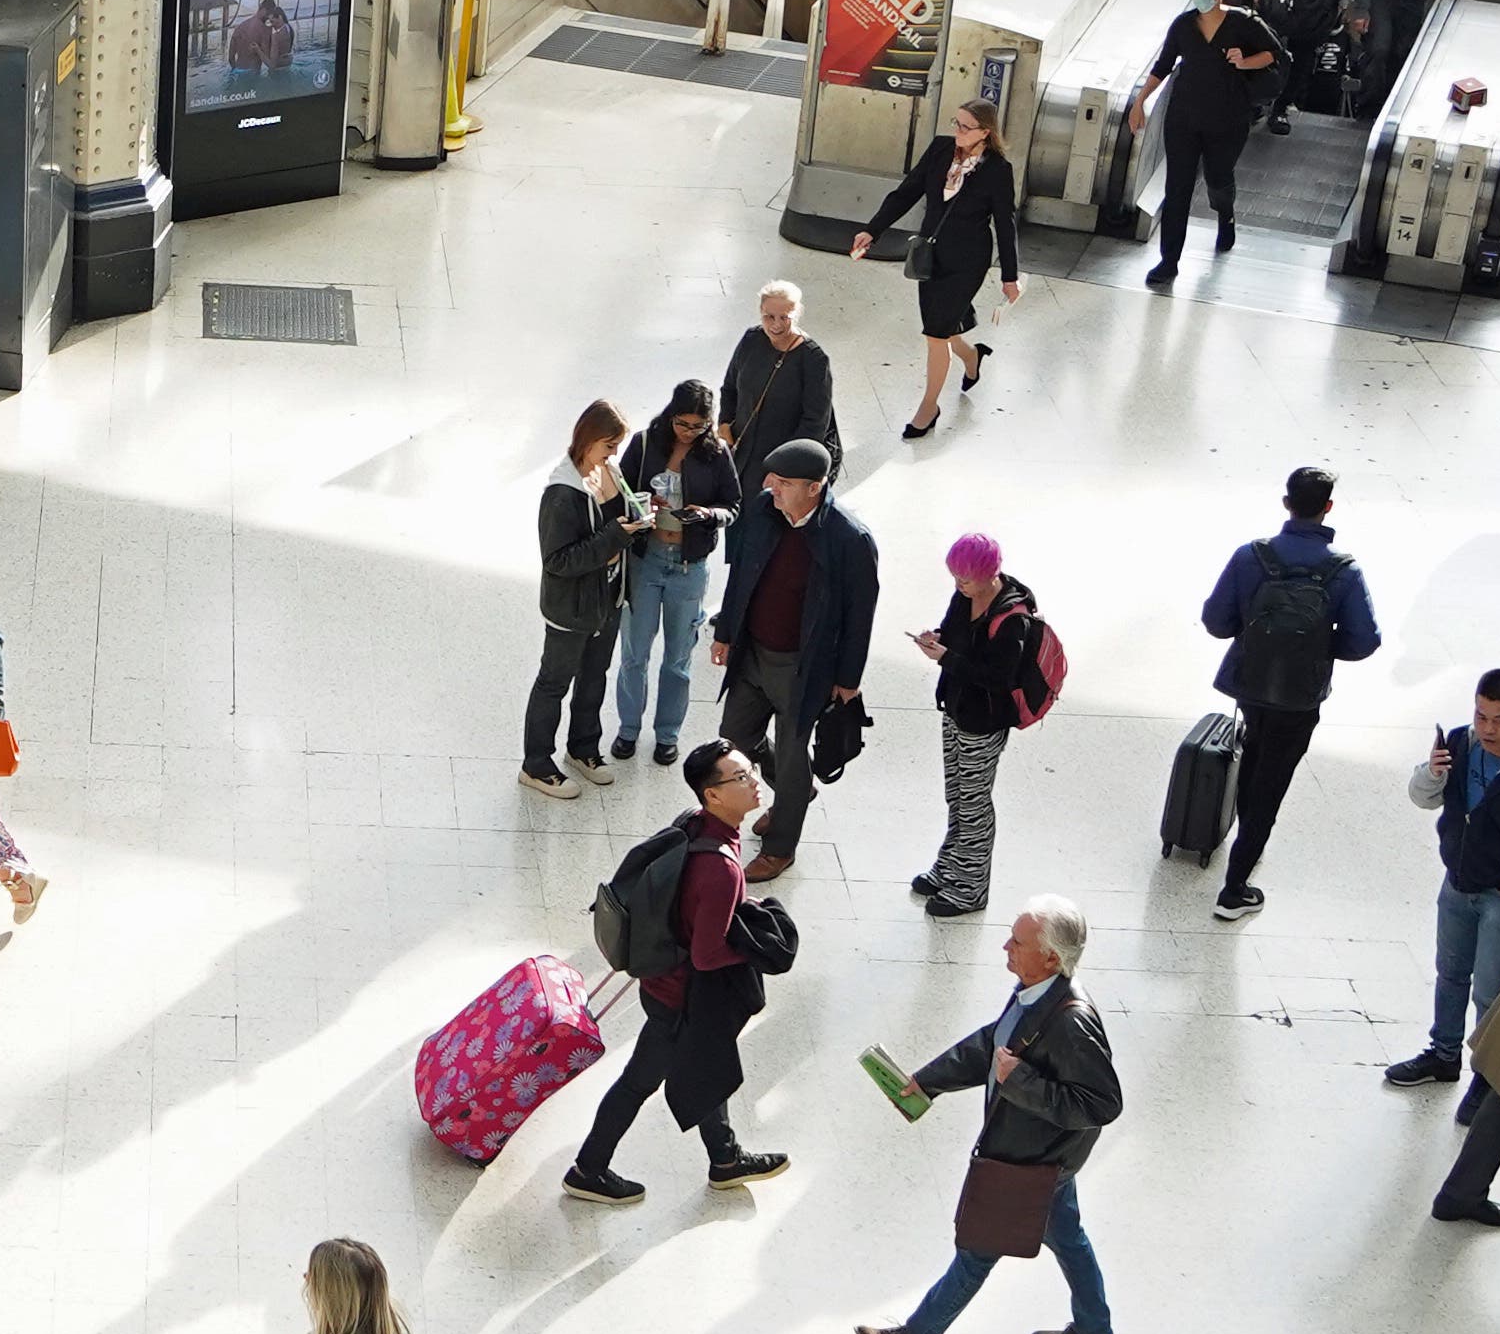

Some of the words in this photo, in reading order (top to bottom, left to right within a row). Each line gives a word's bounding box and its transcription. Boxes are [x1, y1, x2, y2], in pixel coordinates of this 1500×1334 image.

[190, 89, 257, 108] sandals.co.uk
[238, 115, 281, 129] JCDecaux
[1397, 228, 1412, 242] 14
